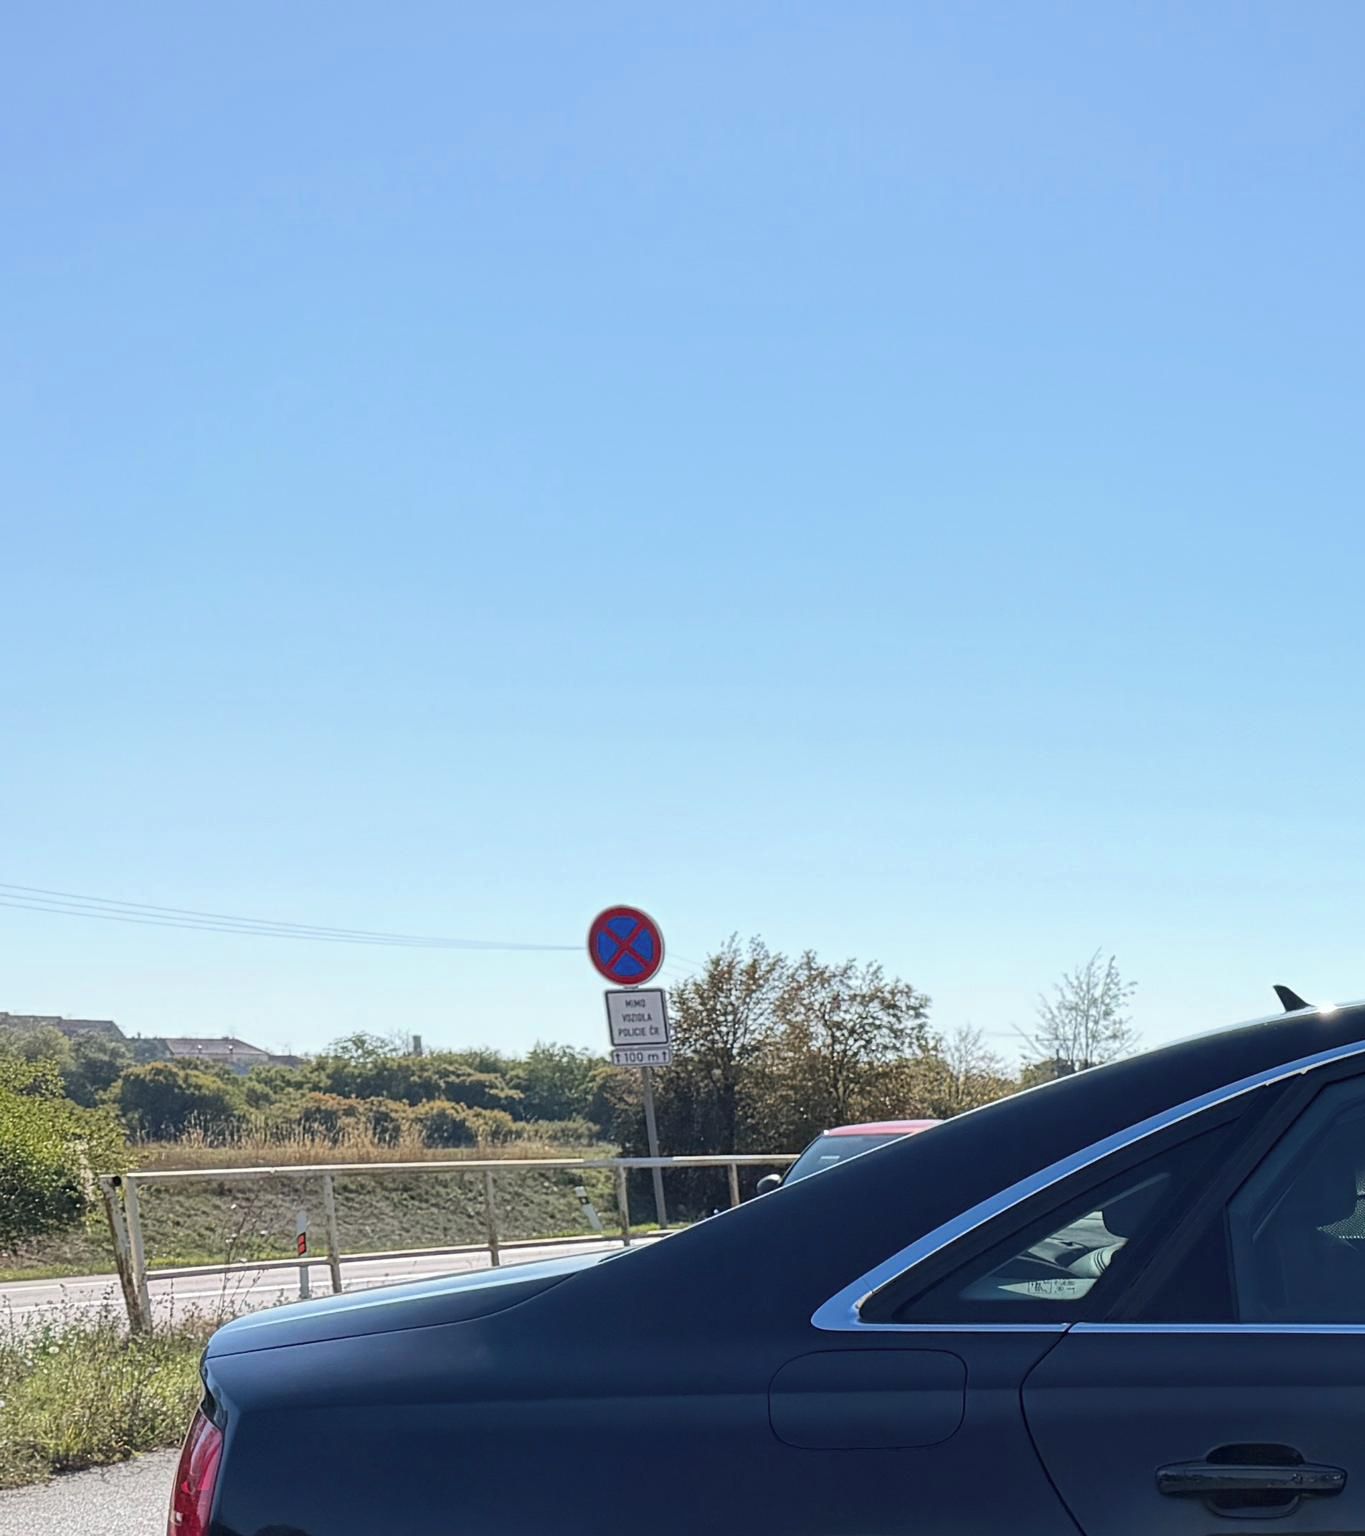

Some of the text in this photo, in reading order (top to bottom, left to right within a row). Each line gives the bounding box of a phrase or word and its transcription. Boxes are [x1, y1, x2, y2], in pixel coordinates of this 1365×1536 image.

[625, 998, 646, 1008] MIMO
[622, 1012, 653, 1022] VOZIDLA
[618, 1024, 660, 1037] POLICIE ČR
[624, 1052, 660, 1063] 100 m
